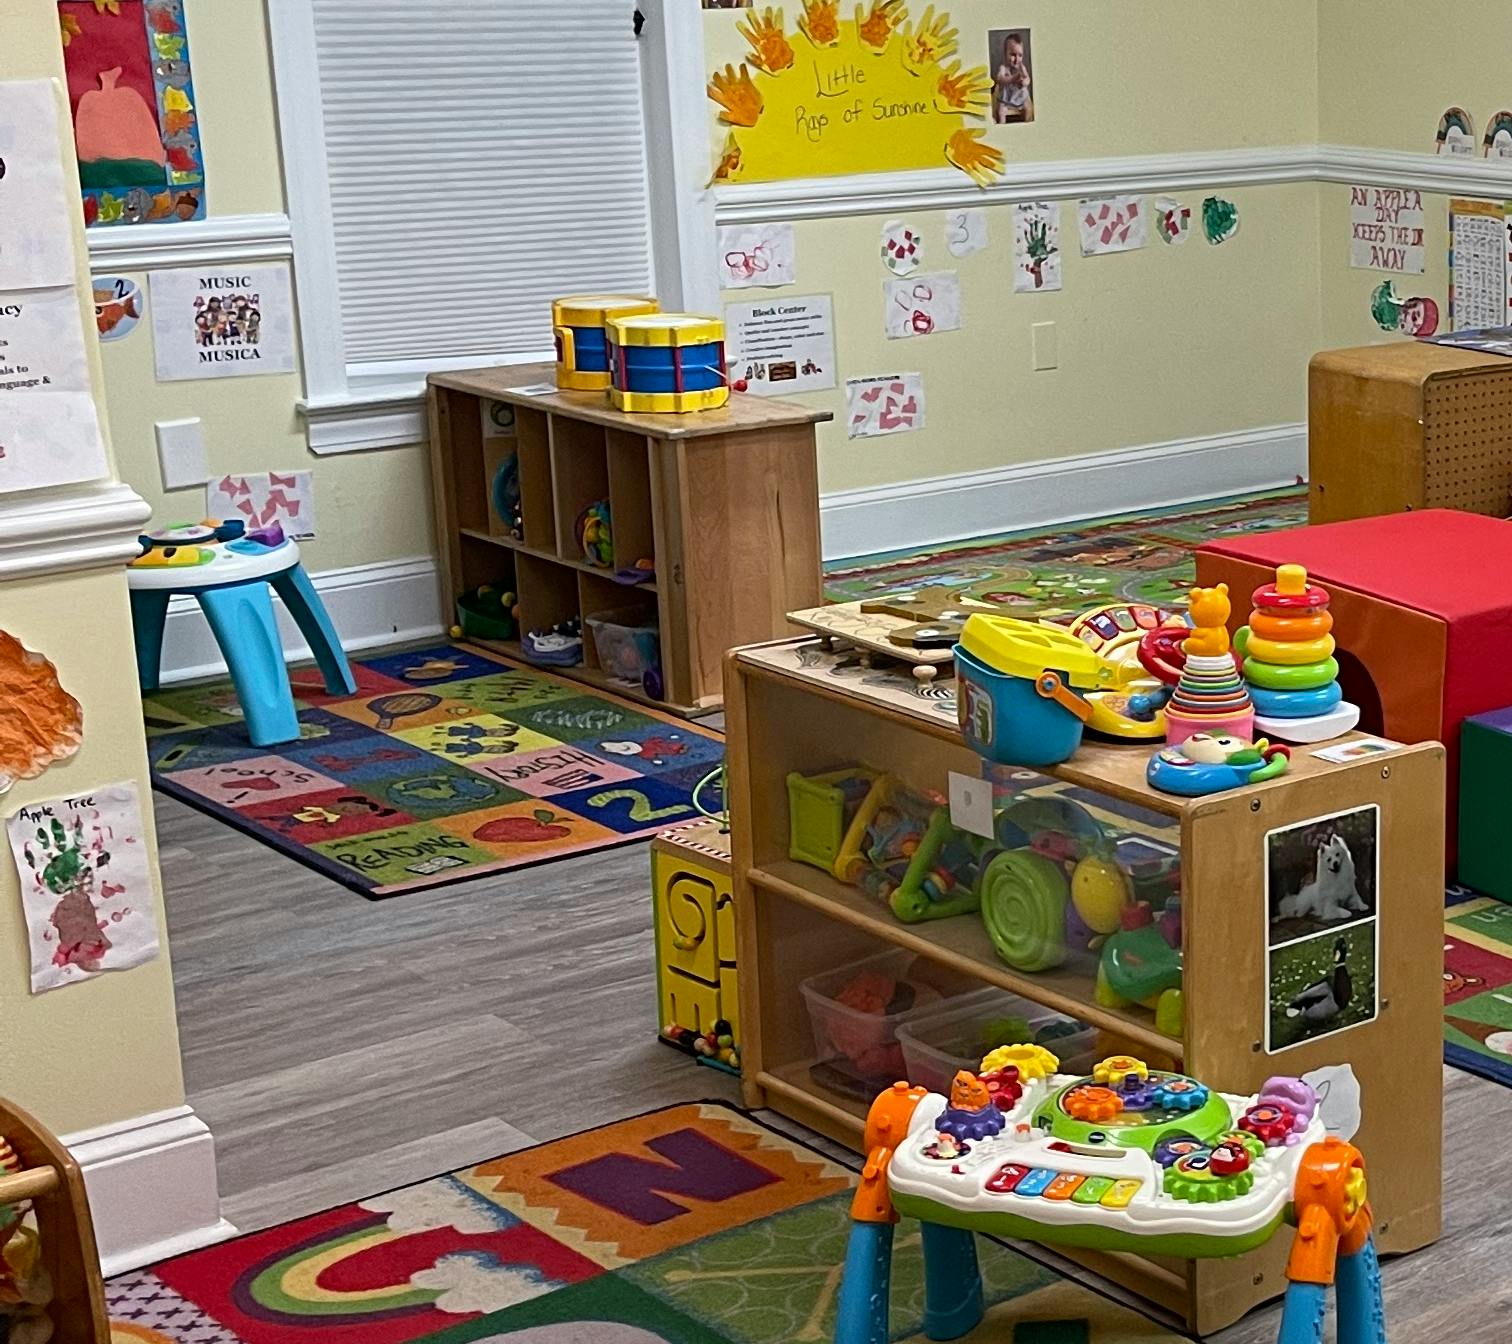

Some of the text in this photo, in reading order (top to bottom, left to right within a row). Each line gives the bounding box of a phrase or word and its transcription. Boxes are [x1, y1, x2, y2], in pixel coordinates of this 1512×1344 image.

[813, 59, 866, 98] Little
[843, 99, 863, 123] of
[1351, 187, 1368, 205] AN
[1411, 191, 1424, 211] A
[1375, 206, 1401, 223] DAY
[951, 214, 970, 244] 3
[1389, 225, 1410, 246] THE
[1369, 246, 1408, 270] AWAY
[114, 279, 130, 299] 2
[199, 276, 251, 290] MUSIC
[752, 306, 807, 317] Block Center
[199, 348, 261, 363] MUSICA
[17, 365, 29, 374] to
[484, 746, 605, 784] HISTORY
[19, 797, 97, 824] Apple Tree
[336, 834, 470, 872] READING
